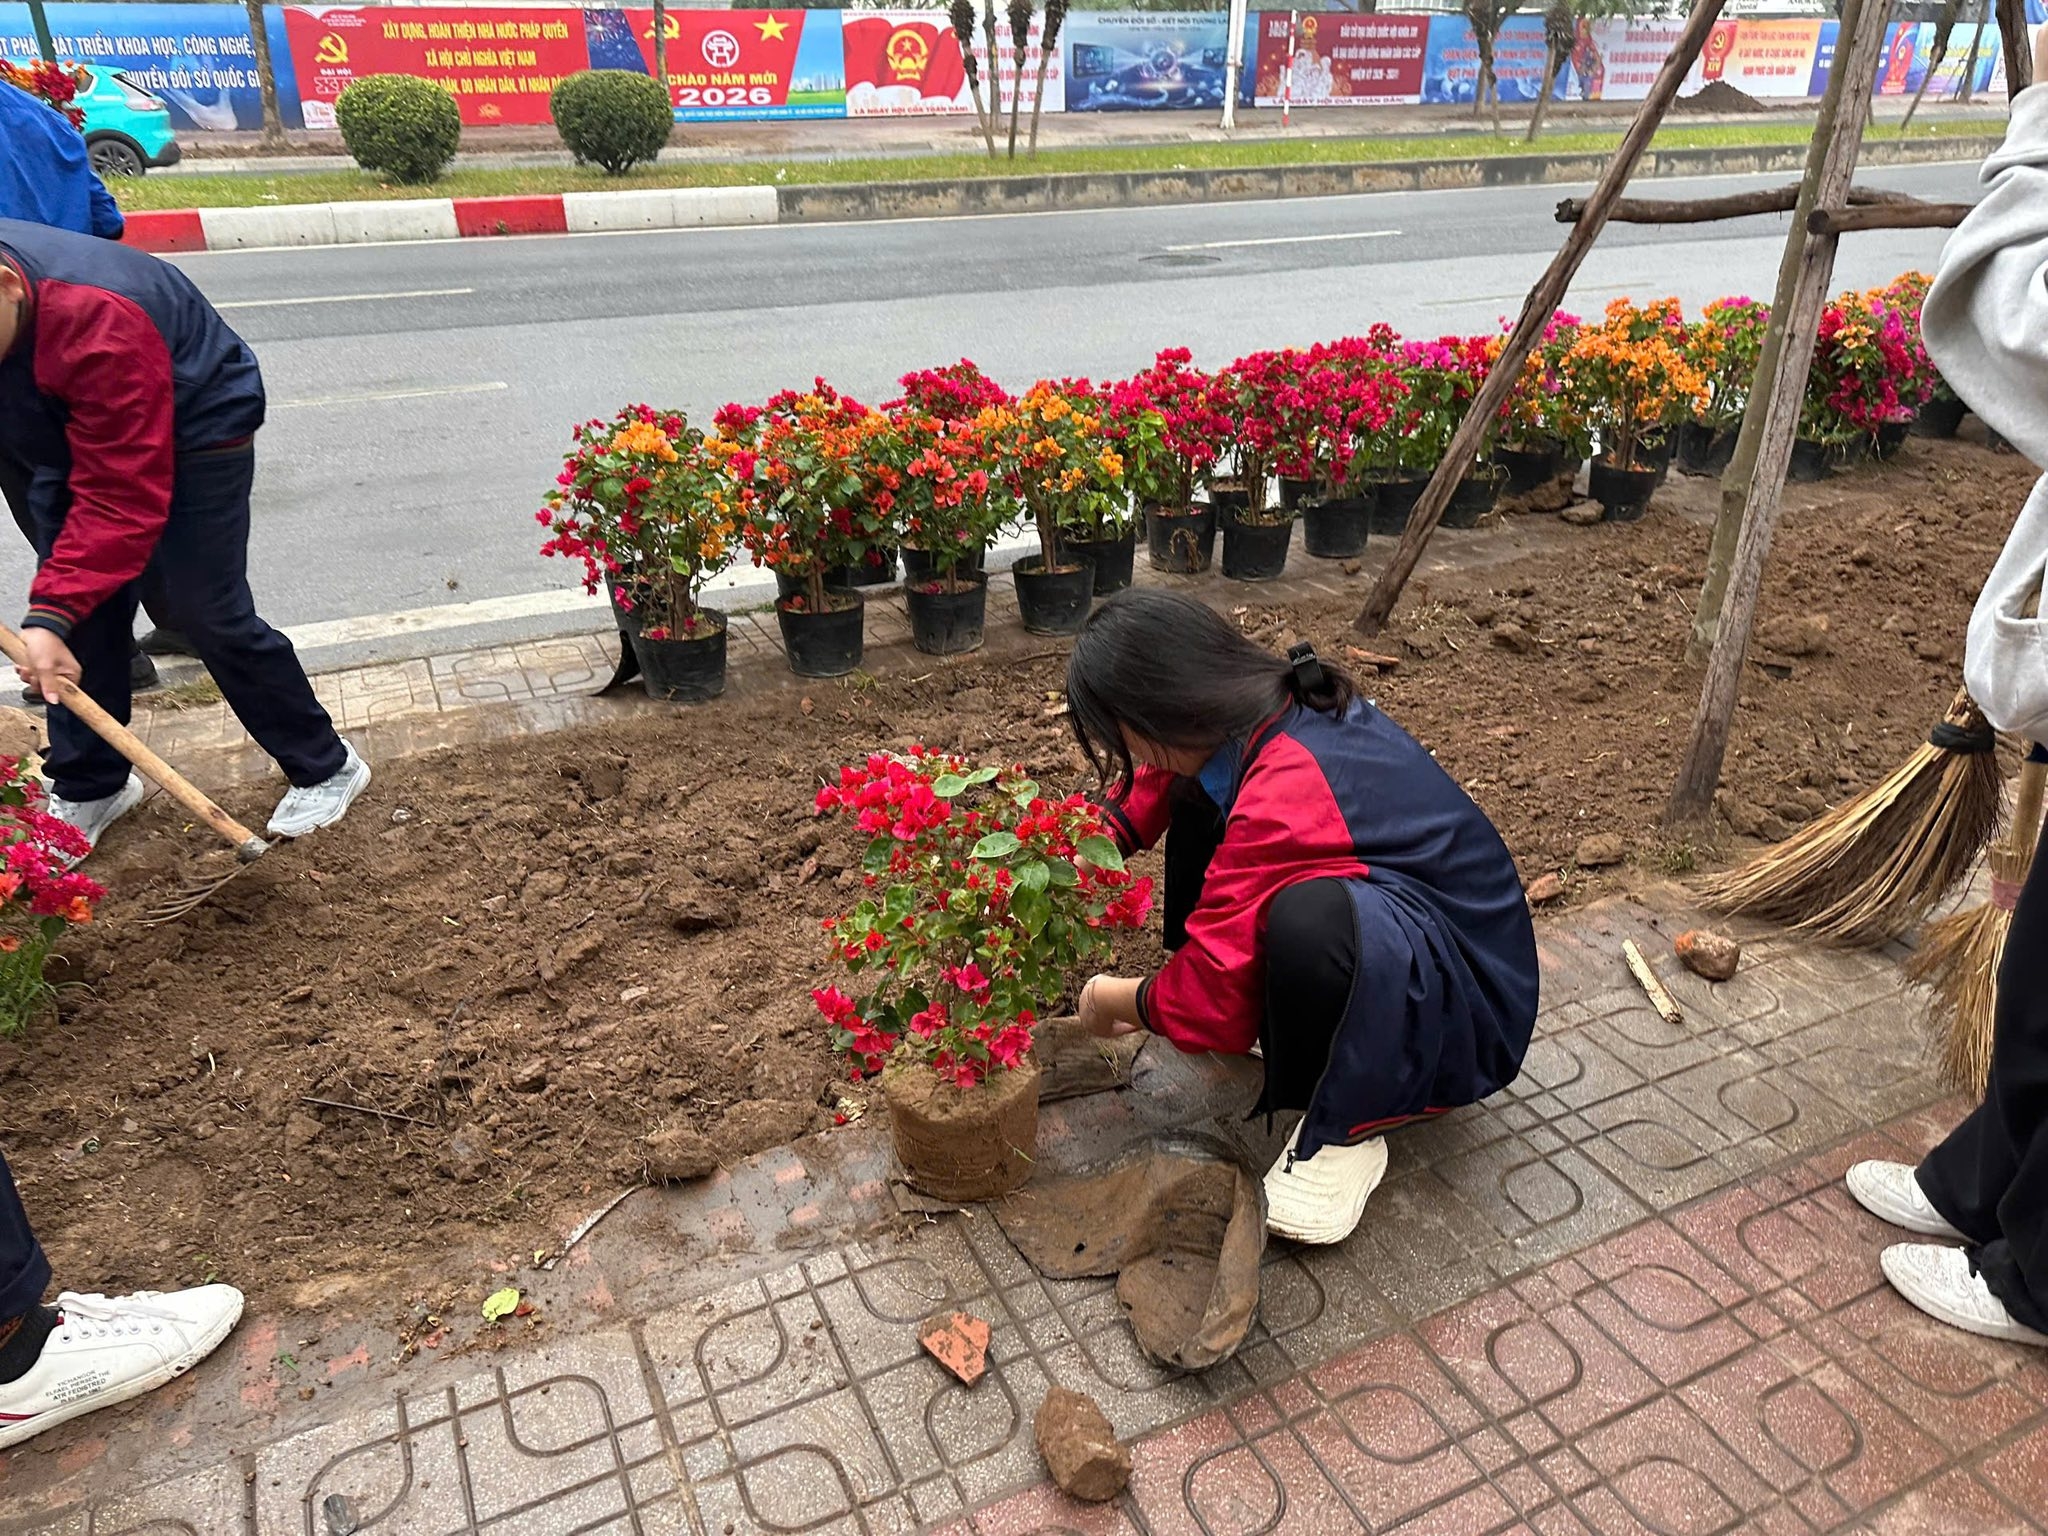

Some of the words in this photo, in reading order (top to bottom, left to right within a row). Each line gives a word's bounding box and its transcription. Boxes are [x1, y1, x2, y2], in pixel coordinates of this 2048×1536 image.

[382, 19, 400, 40] XÂY
[400, 22, 428, 43] DỰNG,
[427, 20, 453, 40] HOÀN
[452, 20, 476, 43] THIỆN
[476, 20, 495, 40] NHÀ
[495, 19, 519, 40] NƯỚC
[519, 20, 542, 40] PHÁP
[542, 19, 568, 41] QUYỀN
[75, 29, 114, 57] TRIỂN
[115, 36, 151, 57] KHOA
[151, 36, 182, 60] HỌC,
[182, 33, 218, 56] CÔNG
[218, 33, 257, 59] NGHỆ,
[425, 47, 439, 67] XÃ
[438, 47, 454, 70] HỘI
[454, 45, 472, 67] CHỦ
[472, 47, 499, 67] NGHĨA
[498, 48, 516, 69] VIỆT
[516, 50, 536, 67] NAM
[169, 64, 193, 90] ĐỔI
[192, 64, 211, 89] SỐ
[212, 64, 245, 91] QUỐC
[246, 69, 262, 89] GI
[336, 66, 352, 77] HỘI
[667, 71, 707, 87] CHÀO
[710, 71, 746, 87] NĂM
[749, 69, 778, 86] MỚI
[461, 77, 473, 93] DO
[473, 74, 498, 94] NHÂN
[518, 74, 527, 93] VÌ
[527, 74, 551, 94] NHÂN
[678, 87, 772, 106] 2026
